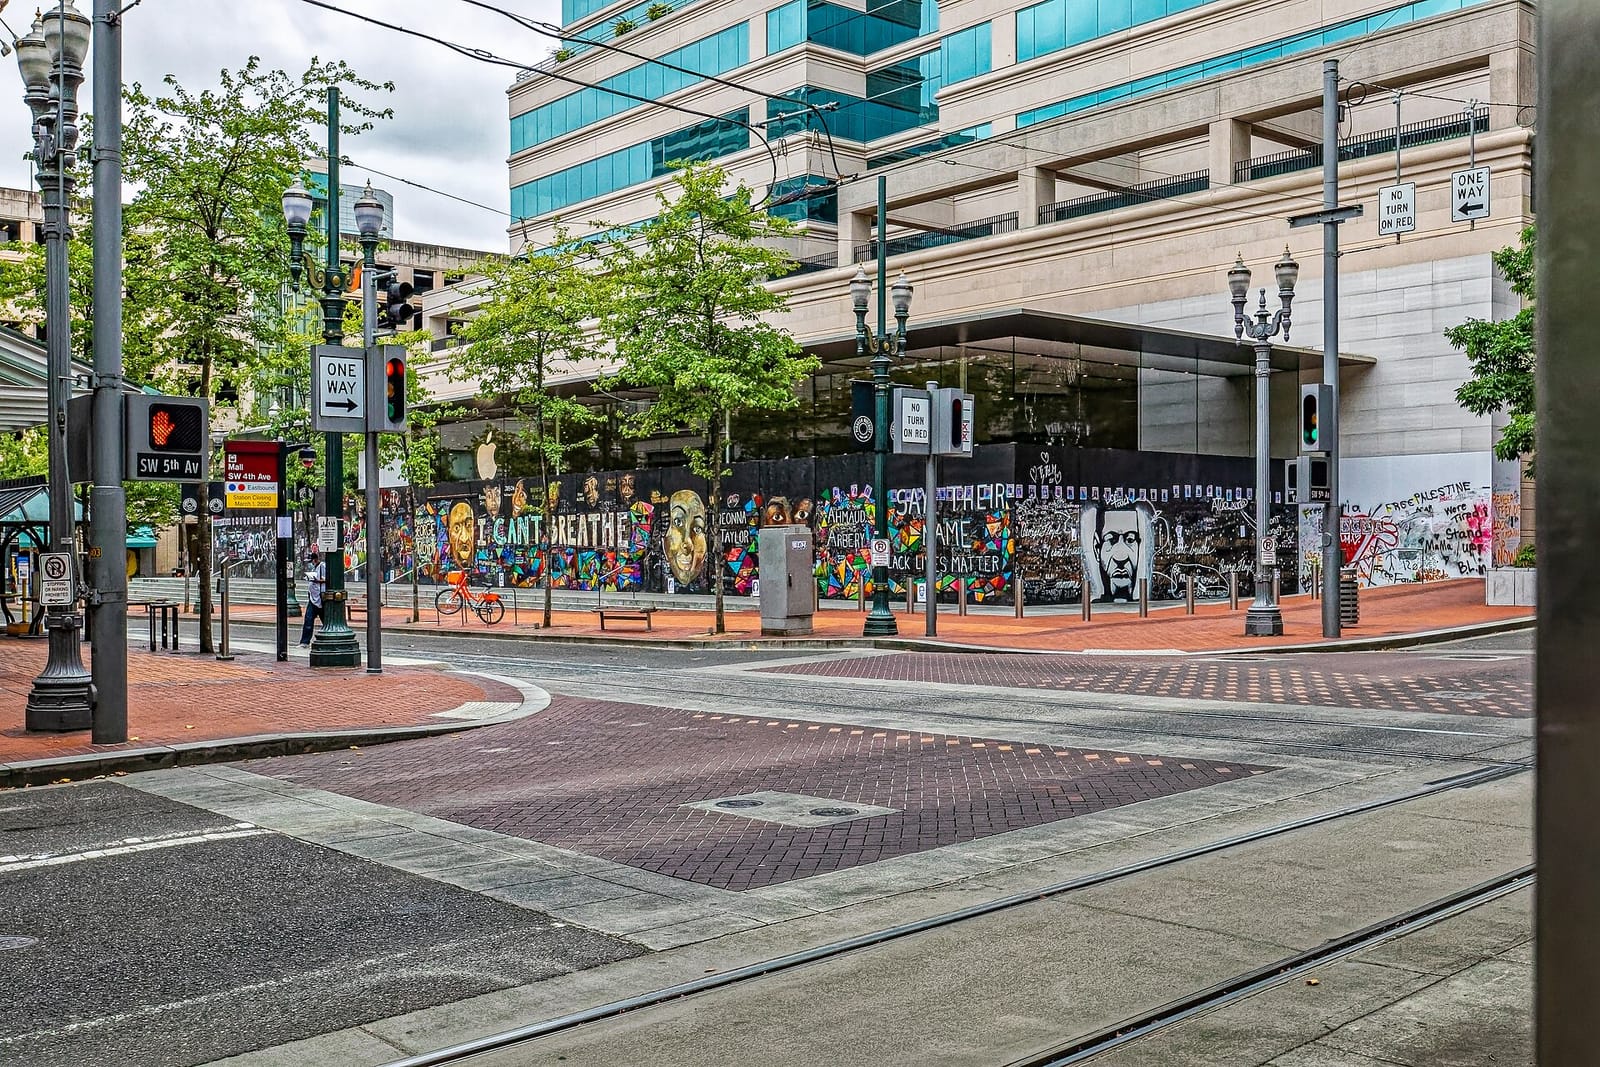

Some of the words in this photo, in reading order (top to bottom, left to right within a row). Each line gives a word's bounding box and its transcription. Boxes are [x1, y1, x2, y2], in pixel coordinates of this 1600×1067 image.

[1458, 172, 1483, 186] ONE
[1391, 190, 1403, 200] NO
[1457, 185, 1485, 200] WAY
[1386, 203, 1408, 215] TURN
[1381, 219, 1393, 229] ON
[1396, 216, 1412, 228] RED
[327, 362, 356, 377] ONE
[327, 380, 357, 395] WAY
[911, 403, 920, 412] NO
[907, 416, 924, 425] TURN
[903, 428, 913, 438] ON
[915, 429, 927, 438] RED
[140, 458, 159, 473] SW
[163, 459, 180, 473] 5th
[184, 460, 199, 474] Av
[228, 463, 244, 471] Mall
[228, 472, 242, 480] SW
[896, 487, 927, 516] SAY
[946, 483, 1005, 512] THEIR
[1385, 499, 1415, 513] FREE
[1413, 481, 1471, 504] PALESTINE
[712, 511, 747, 525] EONNA
[828, 507, 866, 525] AHMAUD
[477, 518, 486, 546] I
[493, 514, 543, 545] CAN'T
[550, 511, 629, 548] BREATHE
[720, 528, 749, 544] TAYLOR
[1445, 521, 1483, 540] Stand
[826, 530, 865, 548] ARBERY
[888, 555, 910, 570] LACK
[915, 555, 948, 573] LIES
[951, 555, 1000, 573] MATTER
